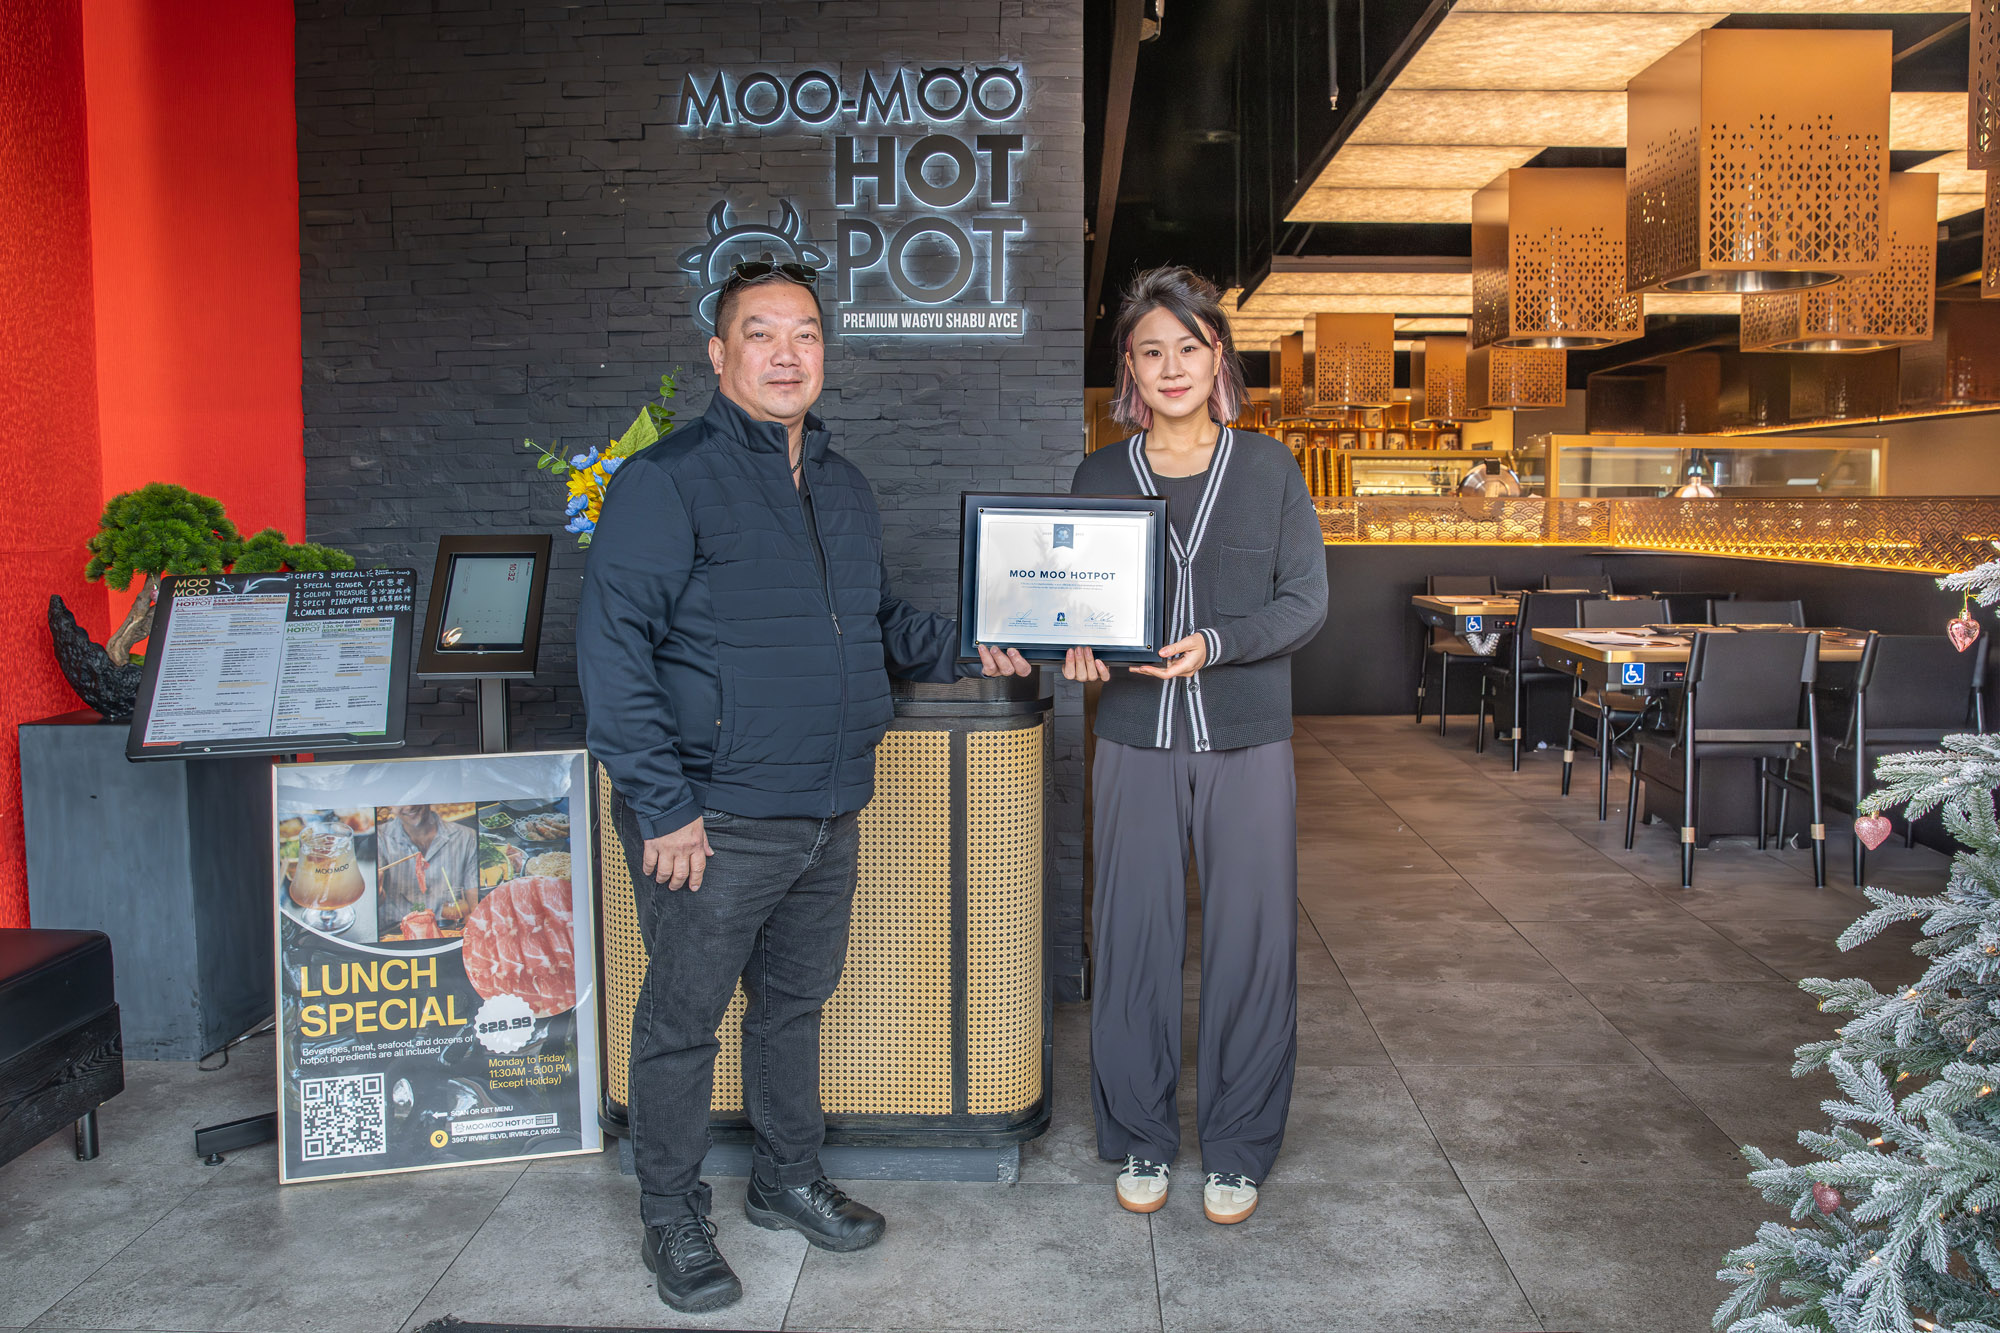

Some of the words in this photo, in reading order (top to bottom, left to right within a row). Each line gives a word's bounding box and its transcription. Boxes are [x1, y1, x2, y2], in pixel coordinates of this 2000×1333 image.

[678, 67, 1023, 127] MOO-MOO
[835, 134, 1023, 207] HOT
[836, 217, 1023, 304] POT
[843, 313, 898, 328] PREMIUM
[901, 313, 943, 328] WAGYU
[945, 313, 985, 328] SHABU
[988, 313, 1018, 328] AYCE
[294, 572, 325, 580] CHEF'S
[331, 571, 365, 579] SPECIAL
[1009, 570, 1036, 578] MOO
[1040, 570, 1066, 579] MOO
[1070, 571, 1116, 580] HOTPOT
[174, 578, 211, 588] MOO
[335, 581, 364, 589] GINGER
[172, 588, 209, 597] MOO
[302, 599, 326, 607] SPICY
[330, 597, 368, 606] PINEAPPLE
[300, 608, 326, 617] CARAMEL
[328, 607, 349, 616] BLACK
[352, 605, 375, 614] PEPPER
[300, 957, 437, 998] LUNCH
[300, 995, 468, 1037] SPECIAL
[479, 1016, 532, 1034] $28.99
[302, 1045, 350, 1057] Beverages,
[352, 1042, 376, 1052] meat,
[378, 1039, 413, 1050] seafood,
[415, 1037, 431, 1046] and
[433, 1035, 462, 1045] dozens
[465, 1034, 473, 1042] of
[300, 1055, 328, 1066] hotpot
[330, 1052, 376, 1063] ingredients
[394, 1049, 404, 1057] all
[405, 1046, 441, 1056] included
[488, 1056, 524, 1068] Monday
[527, 1056, 536, 1064] to
[538, 1054, 565, 1064] Friday
[489, 1067, 526, 1078] 11:30AM
[533, 1065, 554, 1075] 5:00
[555, 1063, 570, 1073] PM
[489, 1079, 523, 1090] (Except
[525, 1074, 561, 1086] Holiday)
[494, 1105, 514, 1113] MENU
[505, 1119, 520, 1127] HOT
[452, 1136, 468, 1144] 3967
[490, 1132, 508, 1141] BLVD,
[540, 1127, 560, 1135] 92602
